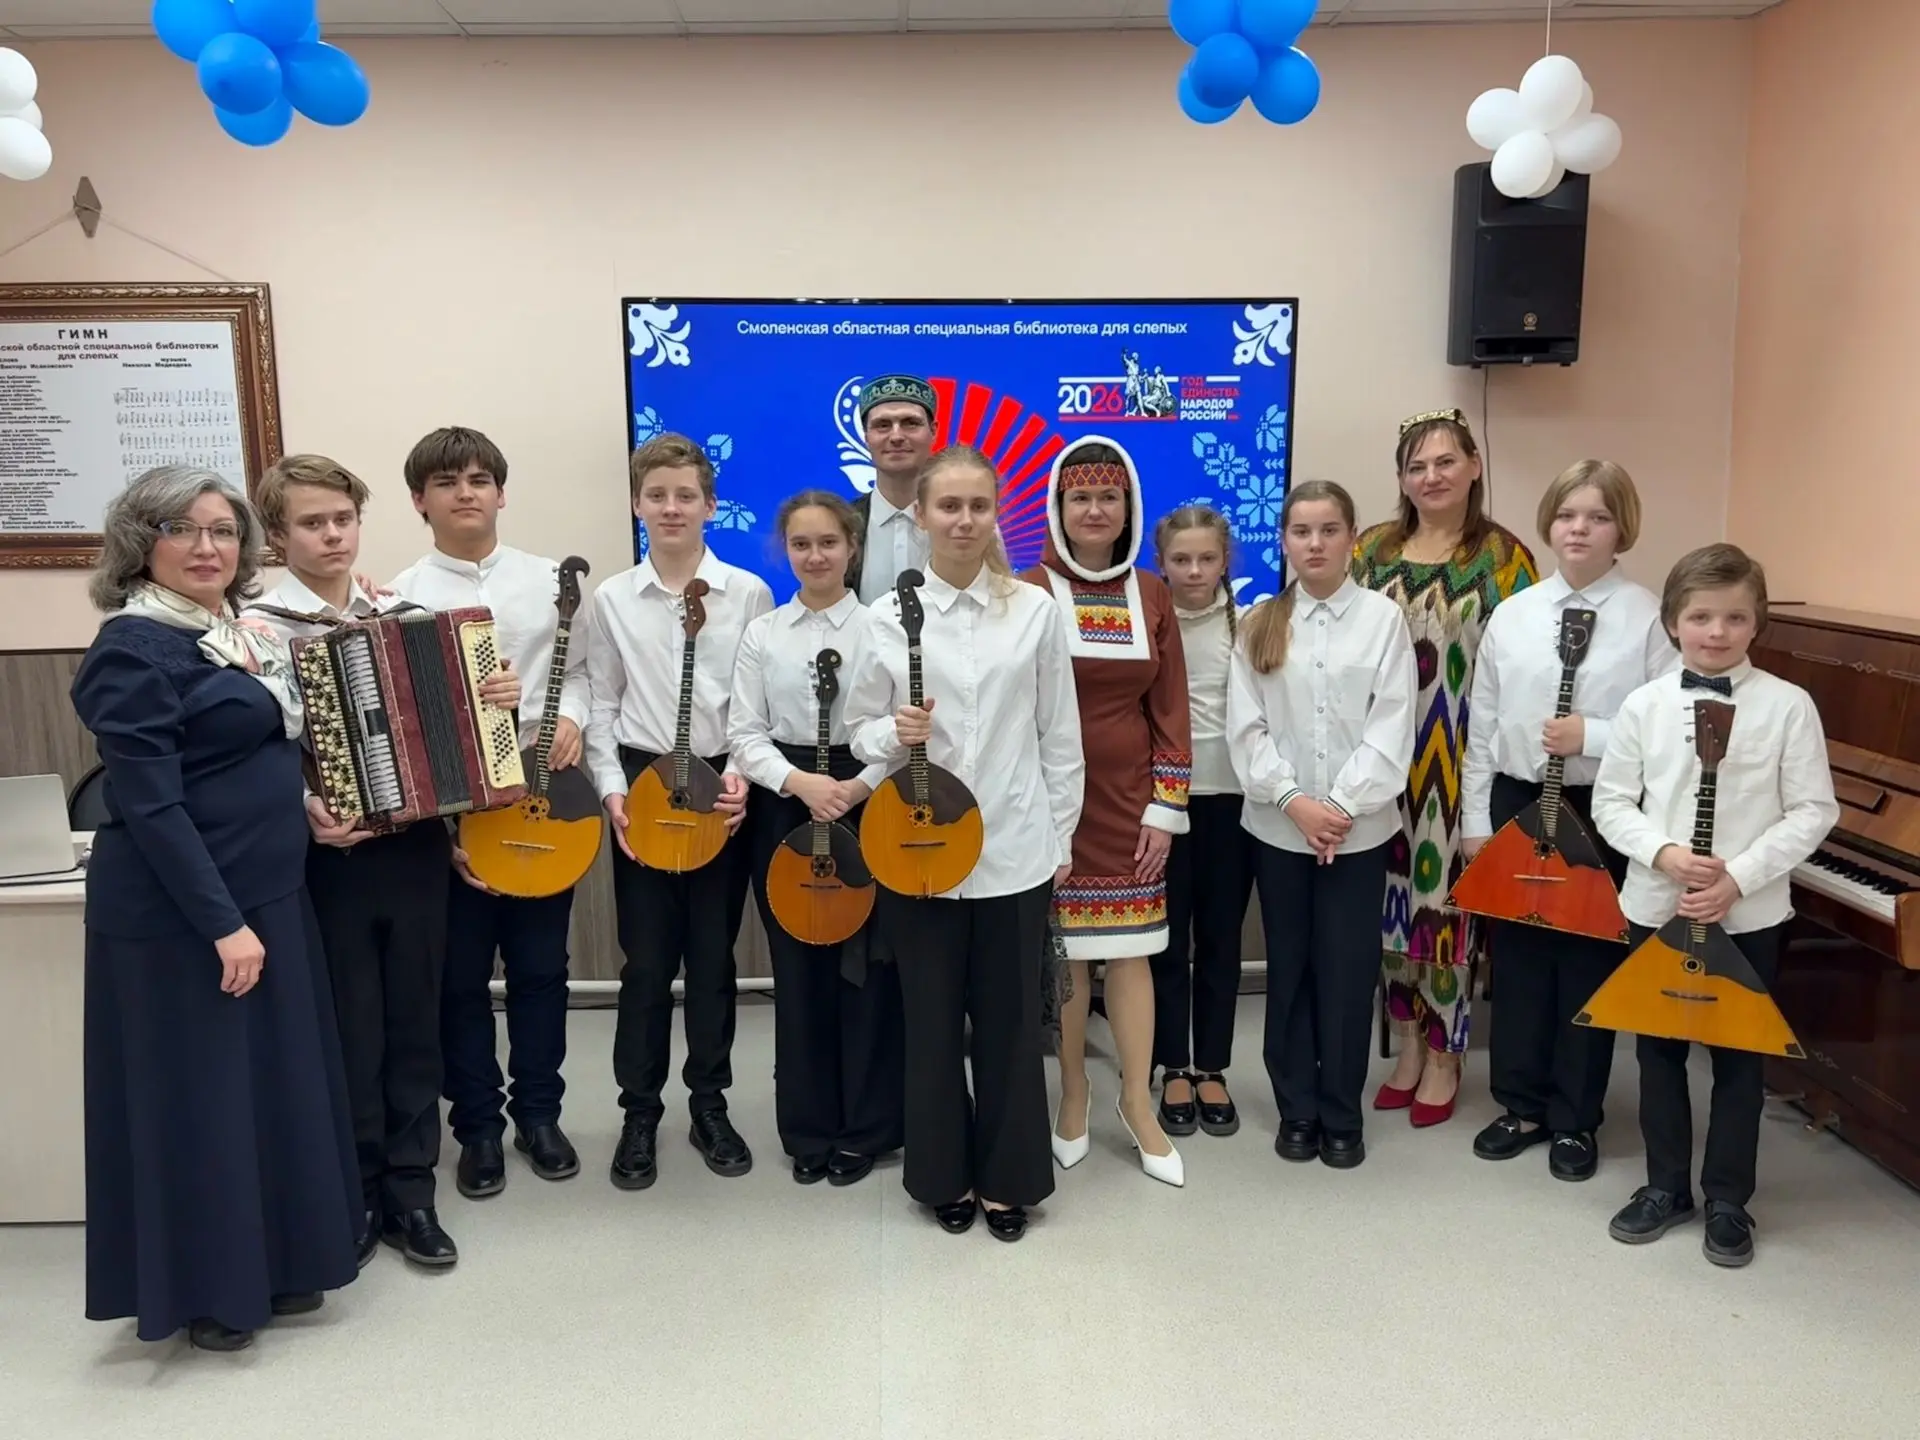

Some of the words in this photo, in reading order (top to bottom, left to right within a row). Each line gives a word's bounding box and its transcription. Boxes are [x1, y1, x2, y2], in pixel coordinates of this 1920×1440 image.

[58, 329, 108, 339] ГИМН
[737, 321, 829, 335] Смоленская
[832, 321, 910, 335] областная
[914, 322, 1010, 337] специальная
[1013, 321, 1099, 335] библиотека
[1101, 323, 1130, 337] для
[1133, 323, 1188, 337] слепых
[0, 343, 24, 352] ской
[27, 342, 80, 351] областной
[83, 341, 153, 351] специальной
[156, 341, 219, 350] библиотеки
[1181, 376, 1204, 388] ГОД
[1181, 387, 1240, 398] ЕДИНСТВА
[1058, 384, 1124, 413] 2026
[1180, 399, 1234, 410] НАРОДОВ
[1180, 410, 1227, 421] РОССИИ
